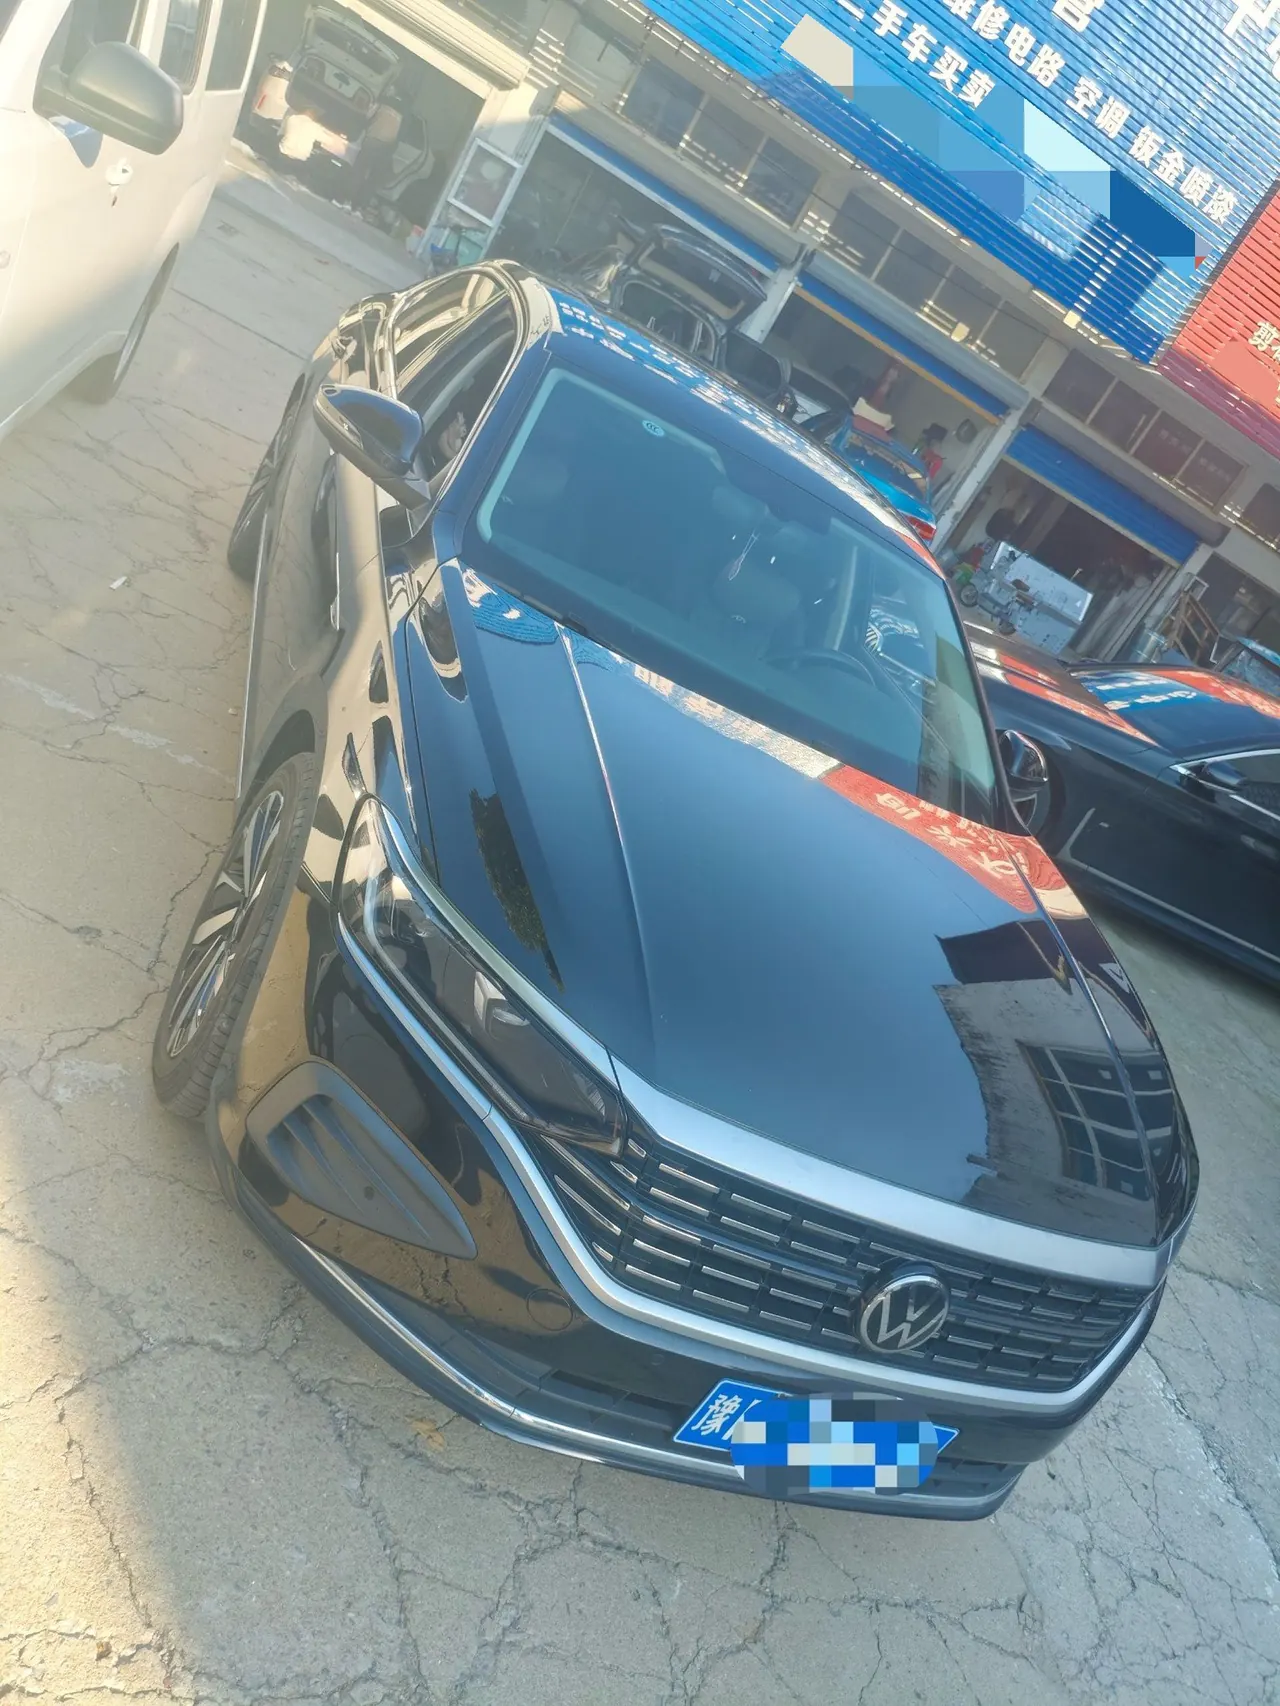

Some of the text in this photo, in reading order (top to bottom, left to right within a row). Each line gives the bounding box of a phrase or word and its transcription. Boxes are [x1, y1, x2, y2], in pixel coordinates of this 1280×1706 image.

[1065, 75, 1131, 139] 空调
[1128, 124, 1240, 225] 钣金喷漆
